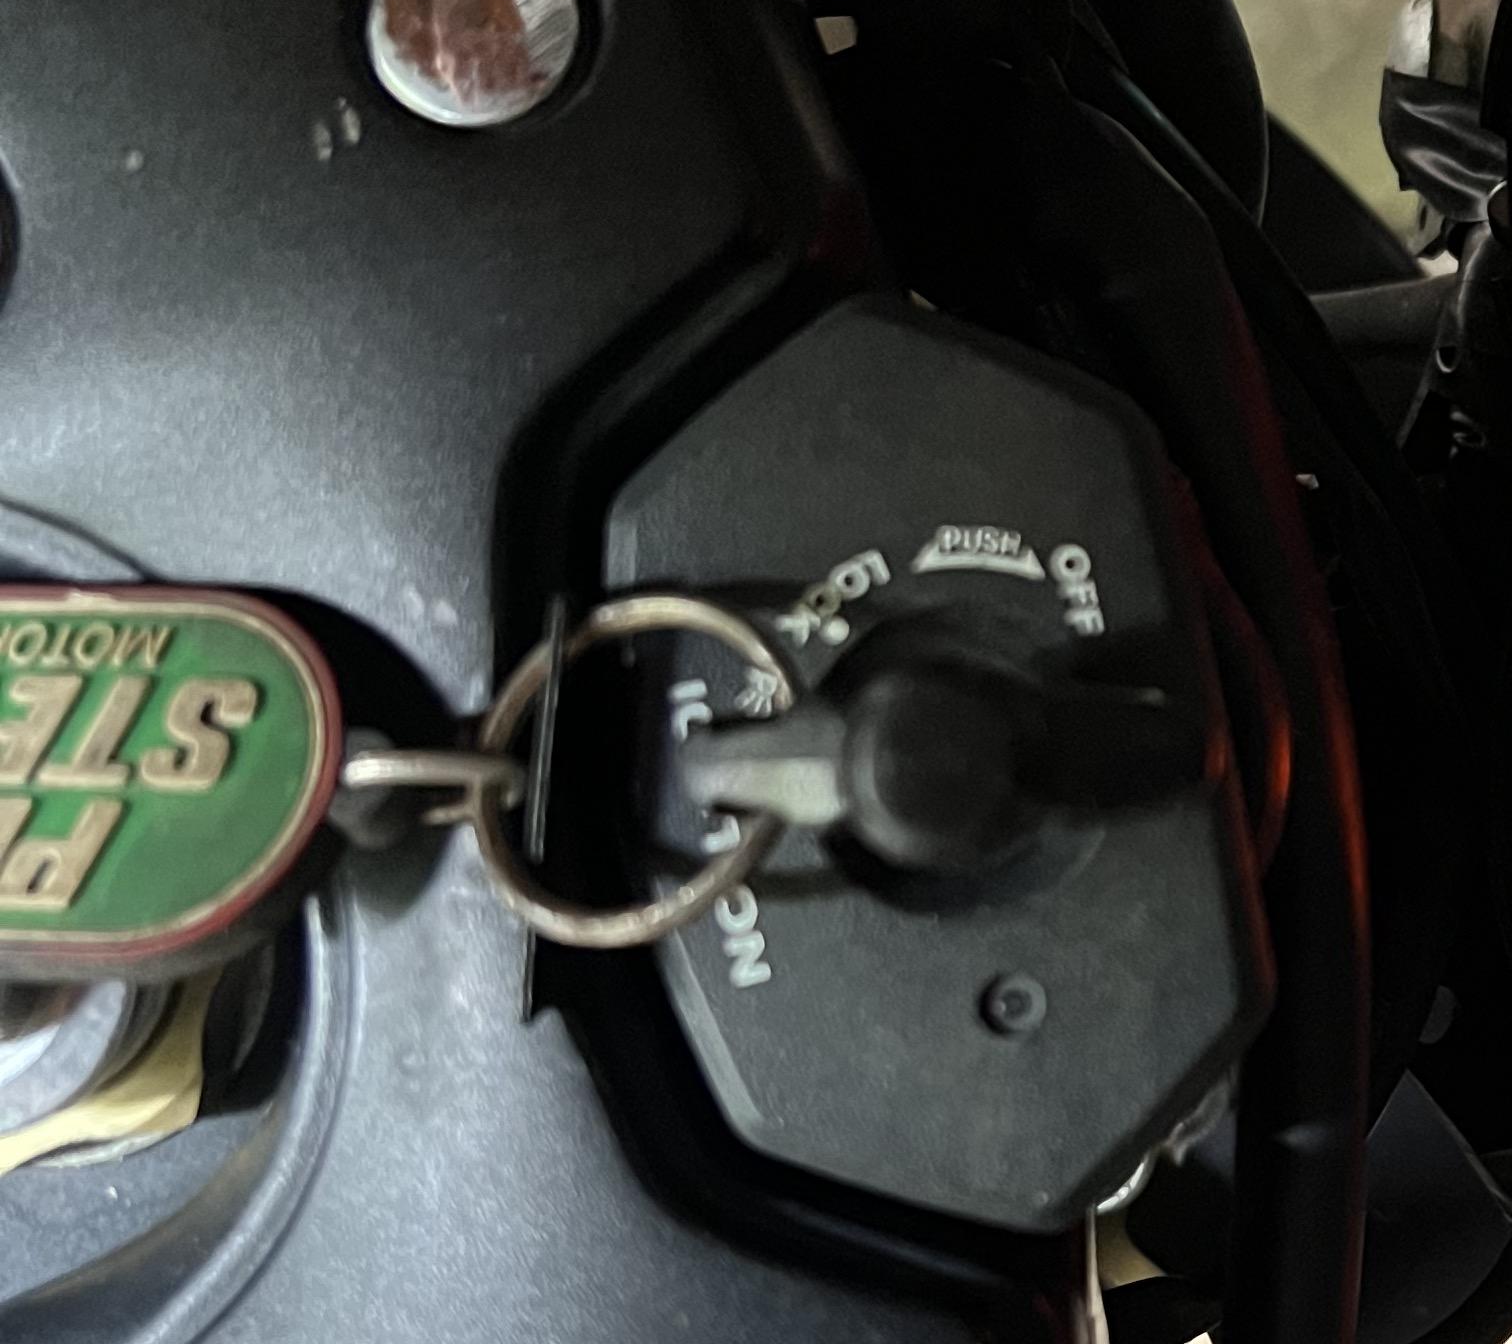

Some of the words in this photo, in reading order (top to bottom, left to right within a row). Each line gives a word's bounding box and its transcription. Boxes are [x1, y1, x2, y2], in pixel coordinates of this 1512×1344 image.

[936, 524, 1022, 556] PUSH
[1050, 544, 1105, 636] OFF
[0, 623, 176, 668] MOTO
